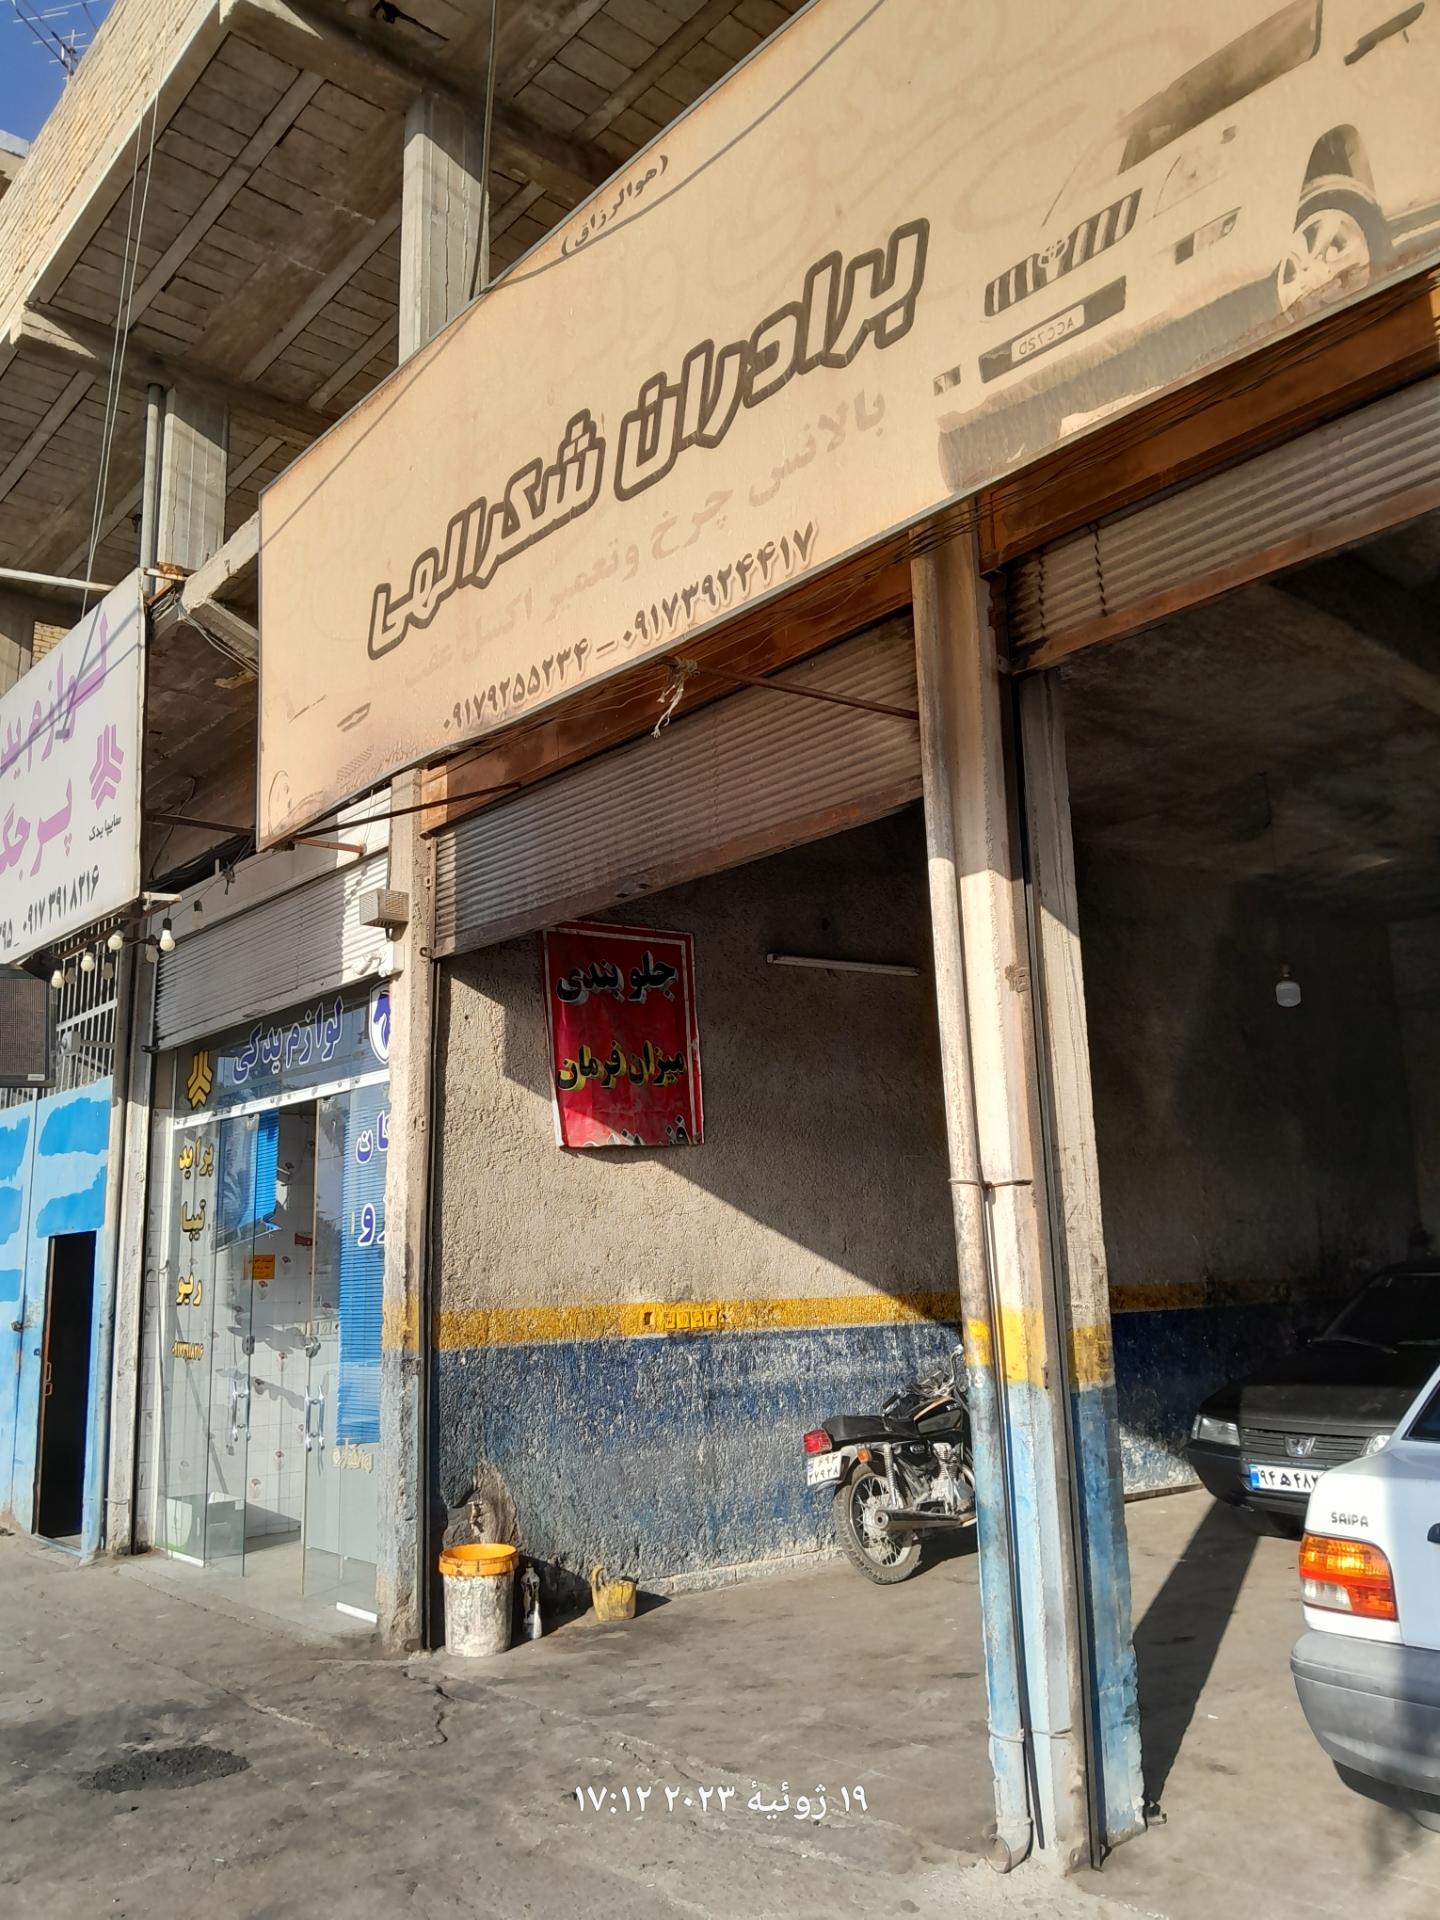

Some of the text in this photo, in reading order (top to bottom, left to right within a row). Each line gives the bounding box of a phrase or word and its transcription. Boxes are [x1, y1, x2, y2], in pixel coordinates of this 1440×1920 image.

[614, 218, 930, 502] برادران
[750, 389, 885, 507] بالانس
[651, 489, 734, 560] چرخ
[623, 521, 814, 642] ۰۹۱۷۳۹۲۴۴۱۷
[28, 611, 108, 774] لوازم
[233, 996, 343, 1084] لوازم یدکی
[557, 1040, 687, 1091] میزان فرمان
[179, 1136, 214, 1179] پراید
[176, 1271, 203, 1306] ریو
[1331, 1511, 1369, 1527] SAIPA
